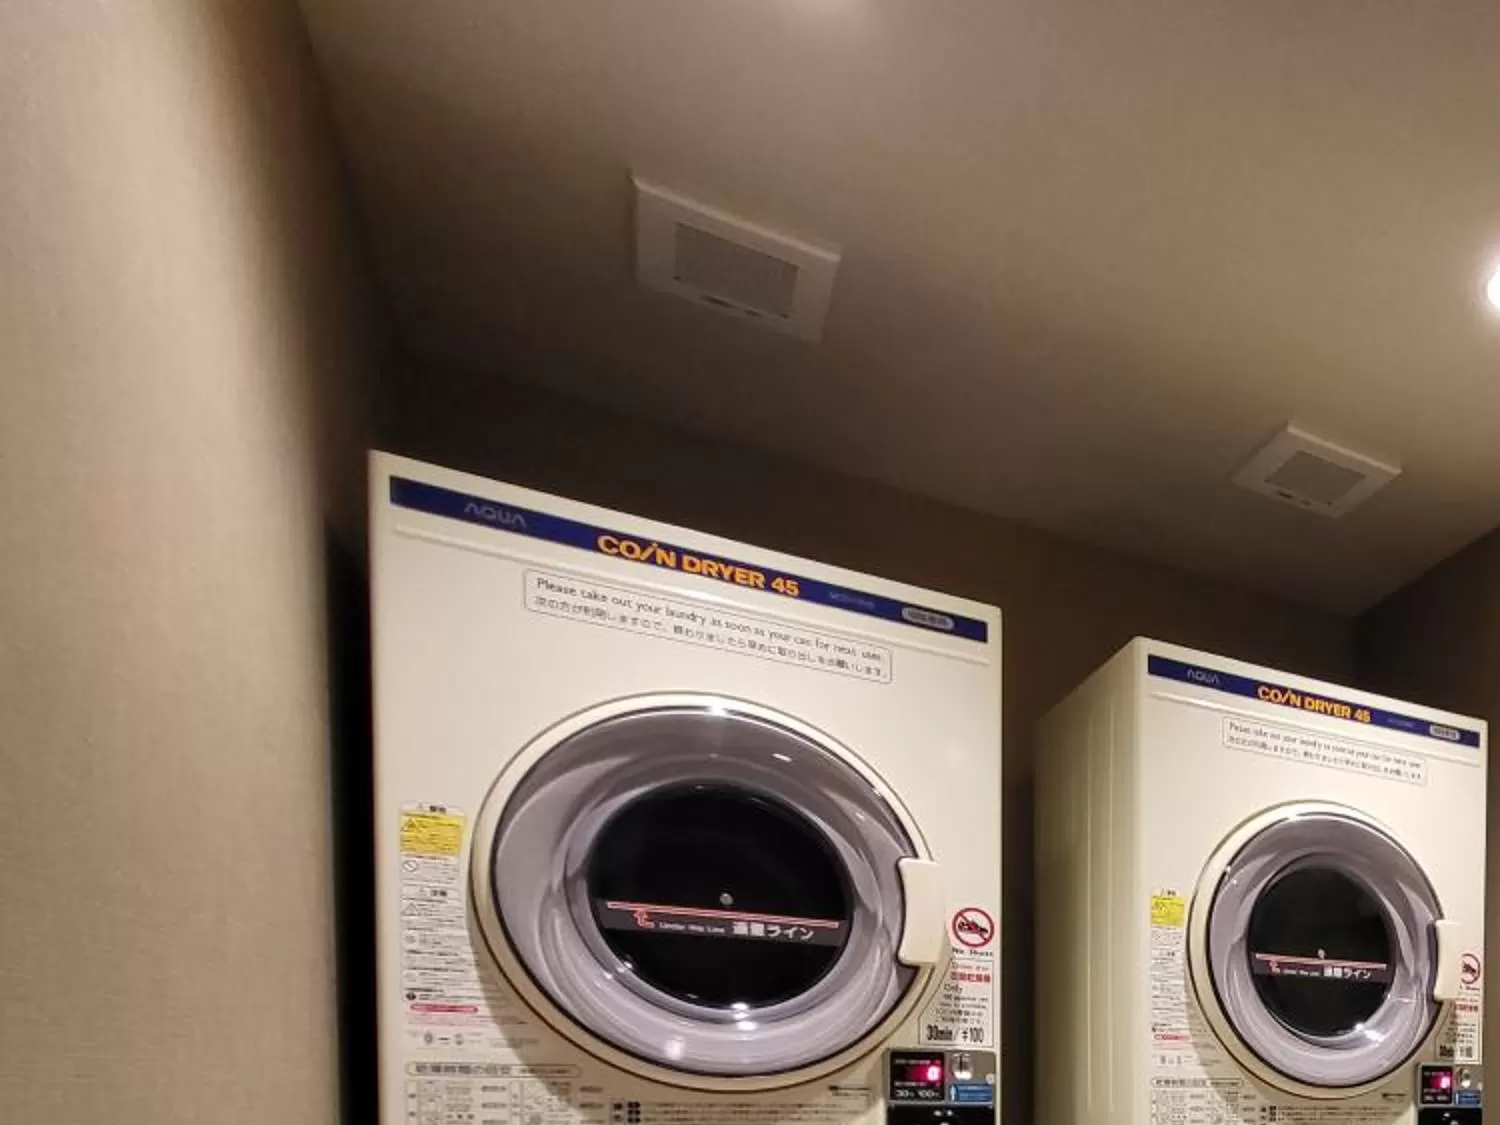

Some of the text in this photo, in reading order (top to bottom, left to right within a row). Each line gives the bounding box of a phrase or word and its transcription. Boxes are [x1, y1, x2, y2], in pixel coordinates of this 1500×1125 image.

[681, 555, 765, 588] DRYER
[770, 577, 801, 597] 45
[537, 577, 578, 598] Please
[580, 588, 608, 603] take
[611, 595, 634, 609] out
[636, 601, 663, 615] your
[665, 604, 707, 626] laundry
[1304, 695, 1351, 718] DRYER
